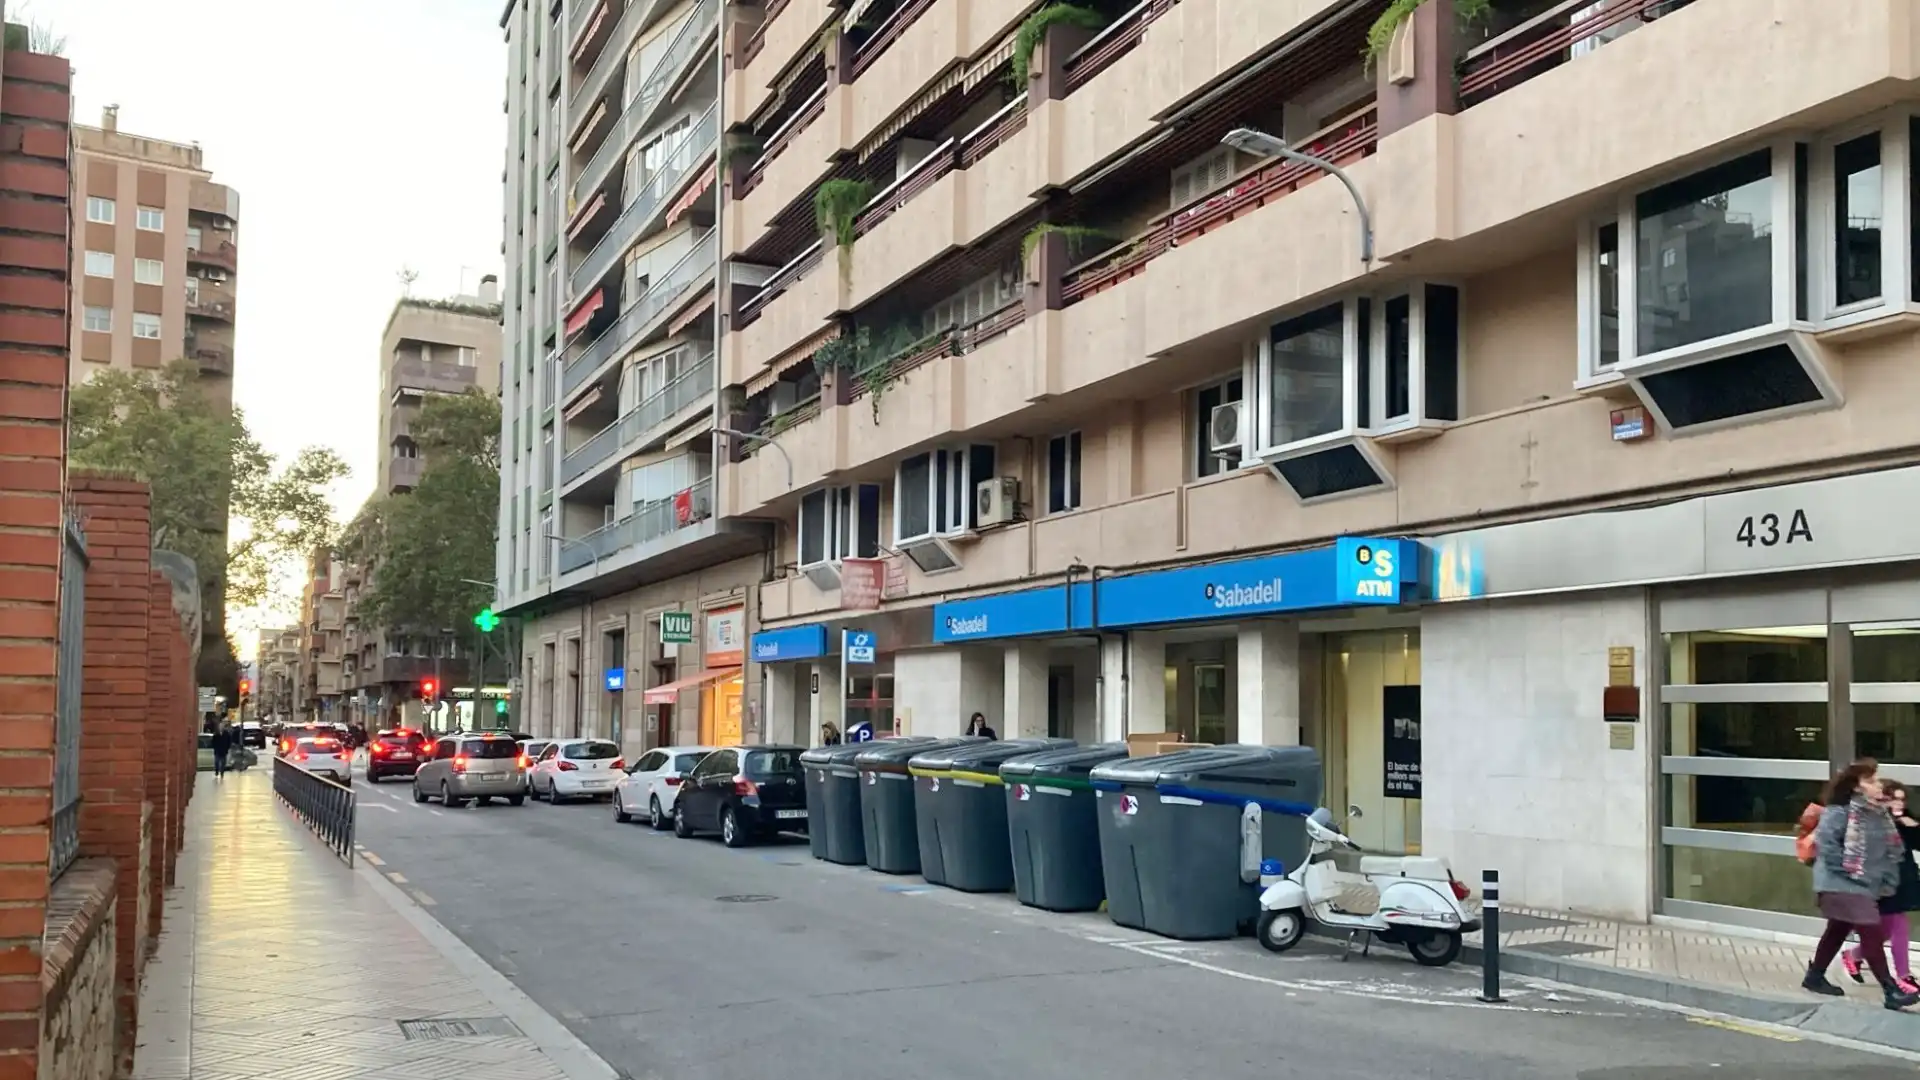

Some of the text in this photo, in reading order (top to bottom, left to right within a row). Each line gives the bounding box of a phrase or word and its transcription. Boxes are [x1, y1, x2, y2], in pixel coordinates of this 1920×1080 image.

[1736, 508, 1813, 547] 43A
[1215, 578, 1282, 609] Sabadell
[1356, 580, 1393, 596] ATM
[951, 614, 988, 635] Sabadell
[859, 729, 870, 743] P
